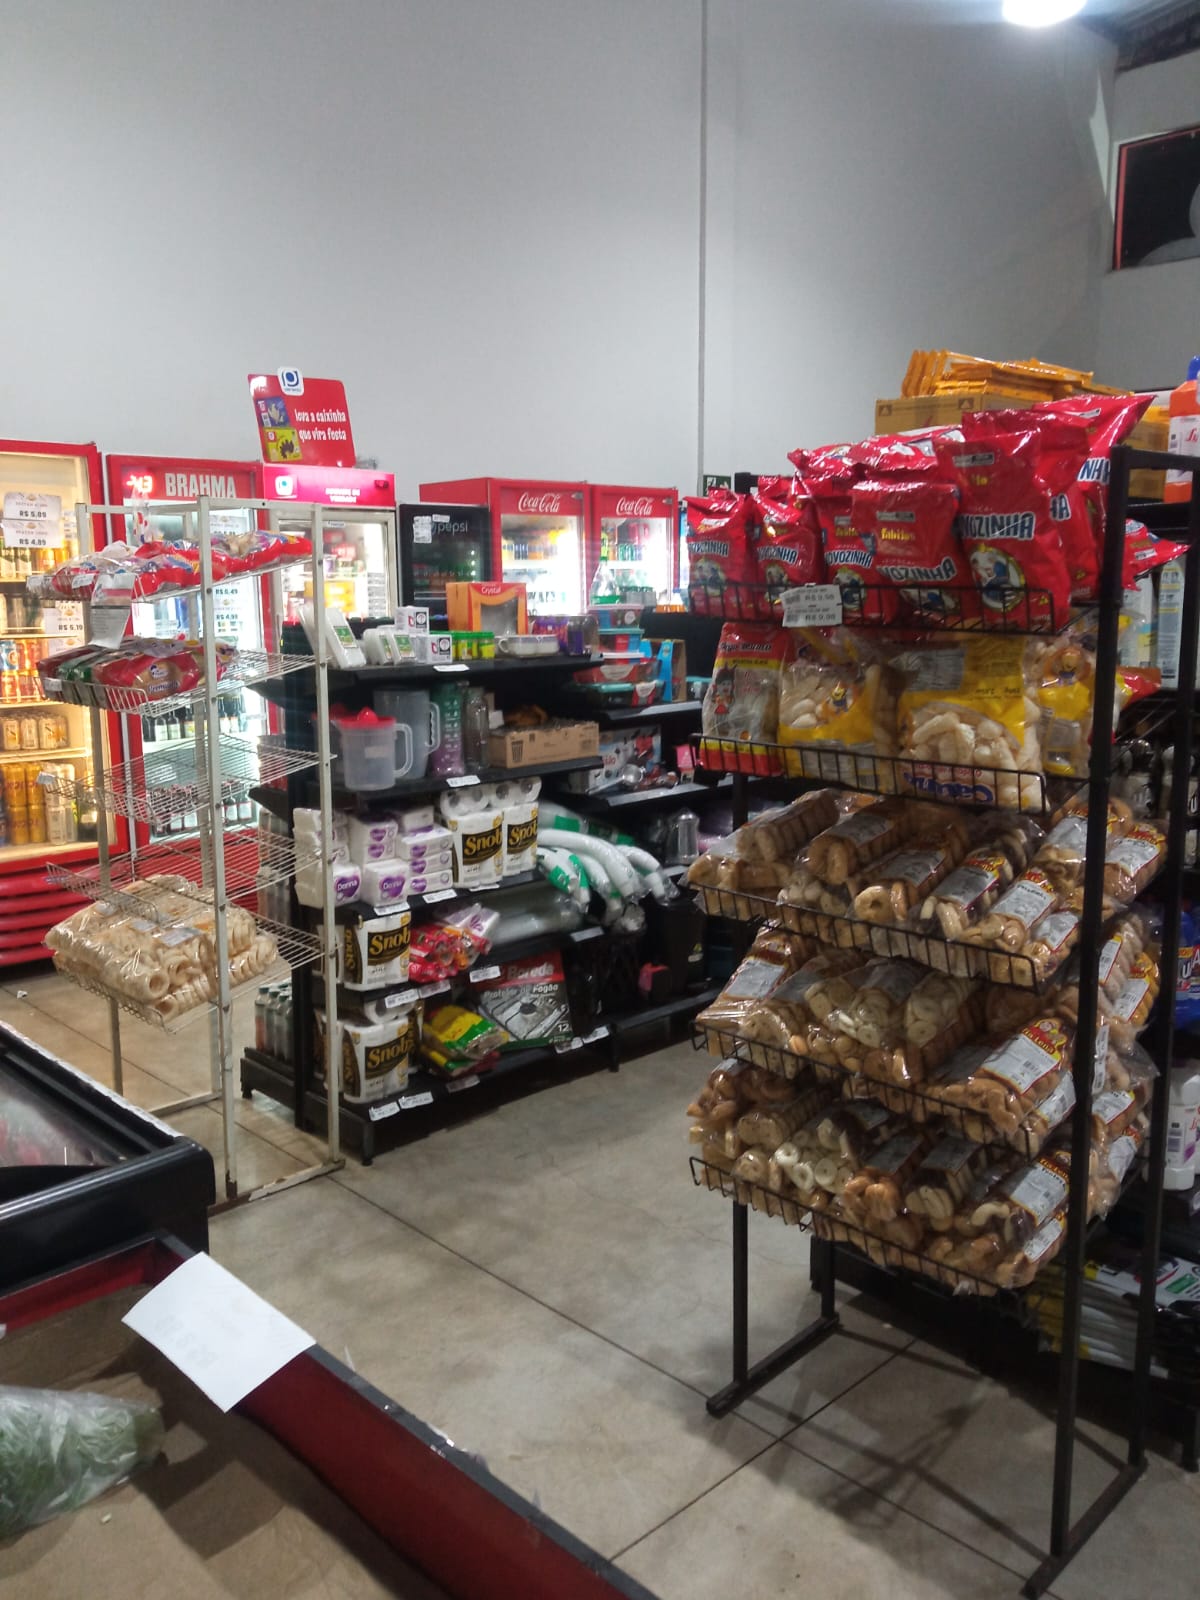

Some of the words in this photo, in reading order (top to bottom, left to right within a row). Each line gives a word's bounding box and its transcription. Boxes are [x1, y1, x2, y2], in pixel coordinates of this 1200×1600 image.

[164, 472, 237, 498] BRAHMA
[437, 520, 468, 536] pepsi
[368, 926, 410, 955] Snob
[532, 983, 559, 994] Fogão
